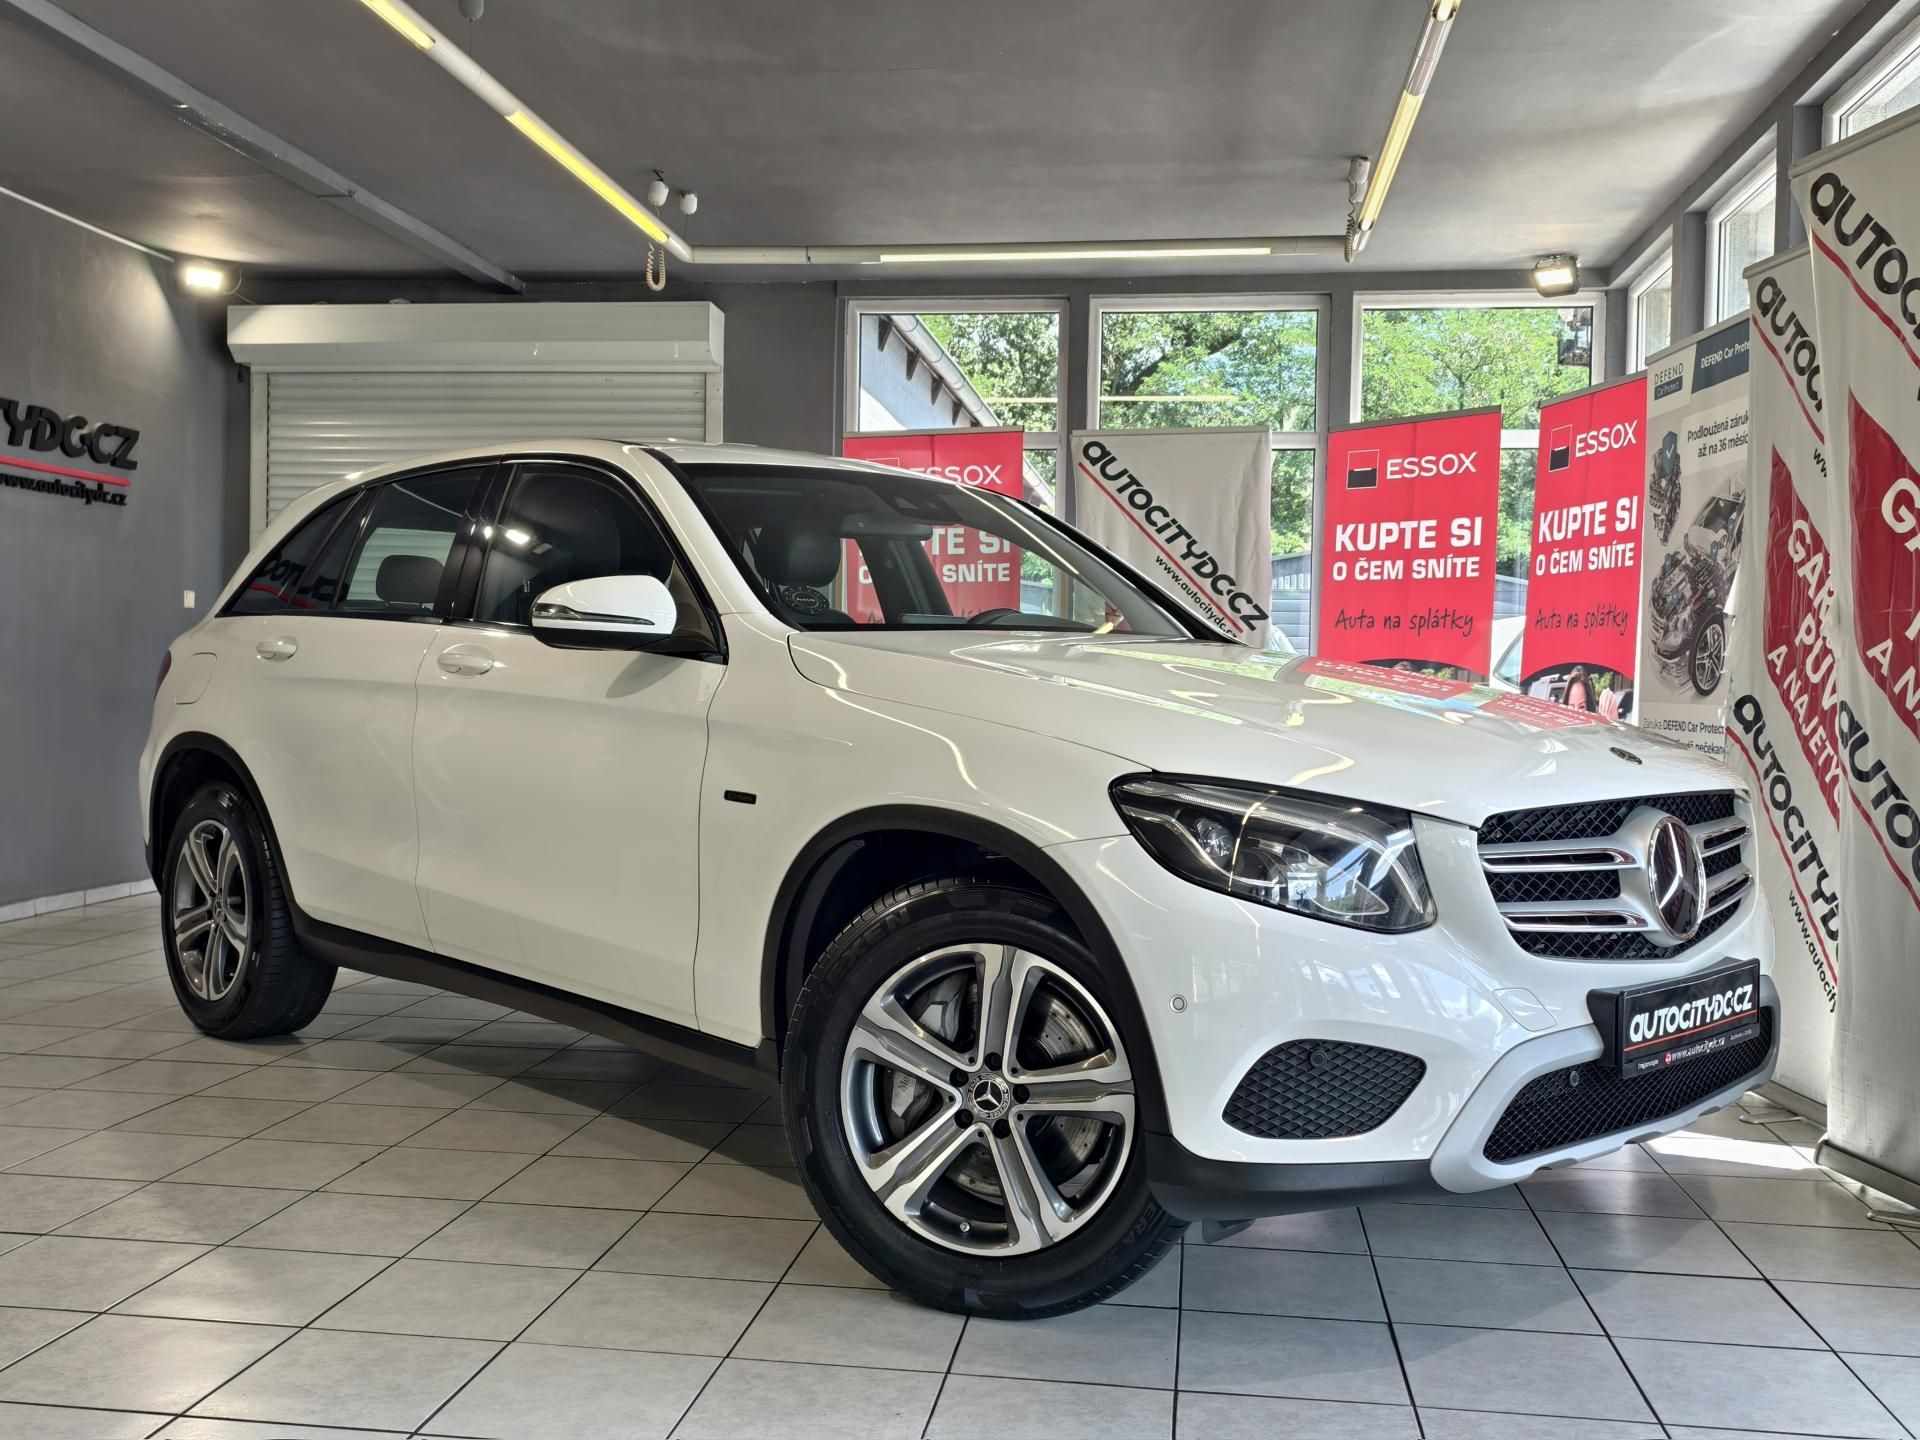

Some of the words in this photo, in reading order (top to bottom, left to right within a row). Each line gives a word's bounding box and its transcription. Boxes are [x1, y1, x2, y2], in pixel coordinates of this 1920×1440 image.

[1700, 351, 1722, 369] DEFEND
[1734, 340, 1751, 354] Prote
[1654, 362, 1683, 385] DEFEND
[1574, 421, 1638, 457] ESSOX
[1385, 451, 1478, 480] ESSOX
[1334, 519, 1437, 552] KUPTE
[1450, 516, 1483, 546] SI
[1538, 501, 1607, 544] KUPTE
[1615, 495, 1638, 532] SI
[942, 560, 1011, 583] SNÍTE
[1332, 560, 1347, 581] O
[1354, 556, 1404, 581] ČEM
[1411, 554, 1480, 580] SNÍTE
[1535, 554, 1546, 576] O
[1550, 547, 1583, 575] ČEM
[1587, 540, 1635, 570] SNÍTE
[1334, 608, 1376, 631] Auta
[1383, 614, 1401, 631] na
[1408, 607, 1474, 637] splátky
[1535, 607, 1562, 630] Auta
[1566, 611, 1579, 630] na
[1584, 603, 1629, 637] splátky
[1663, 720, 1686, 731] DEFEND
[1687, 721, 1698, 733] Car
[1700, 722, 1724, 735] Protect
